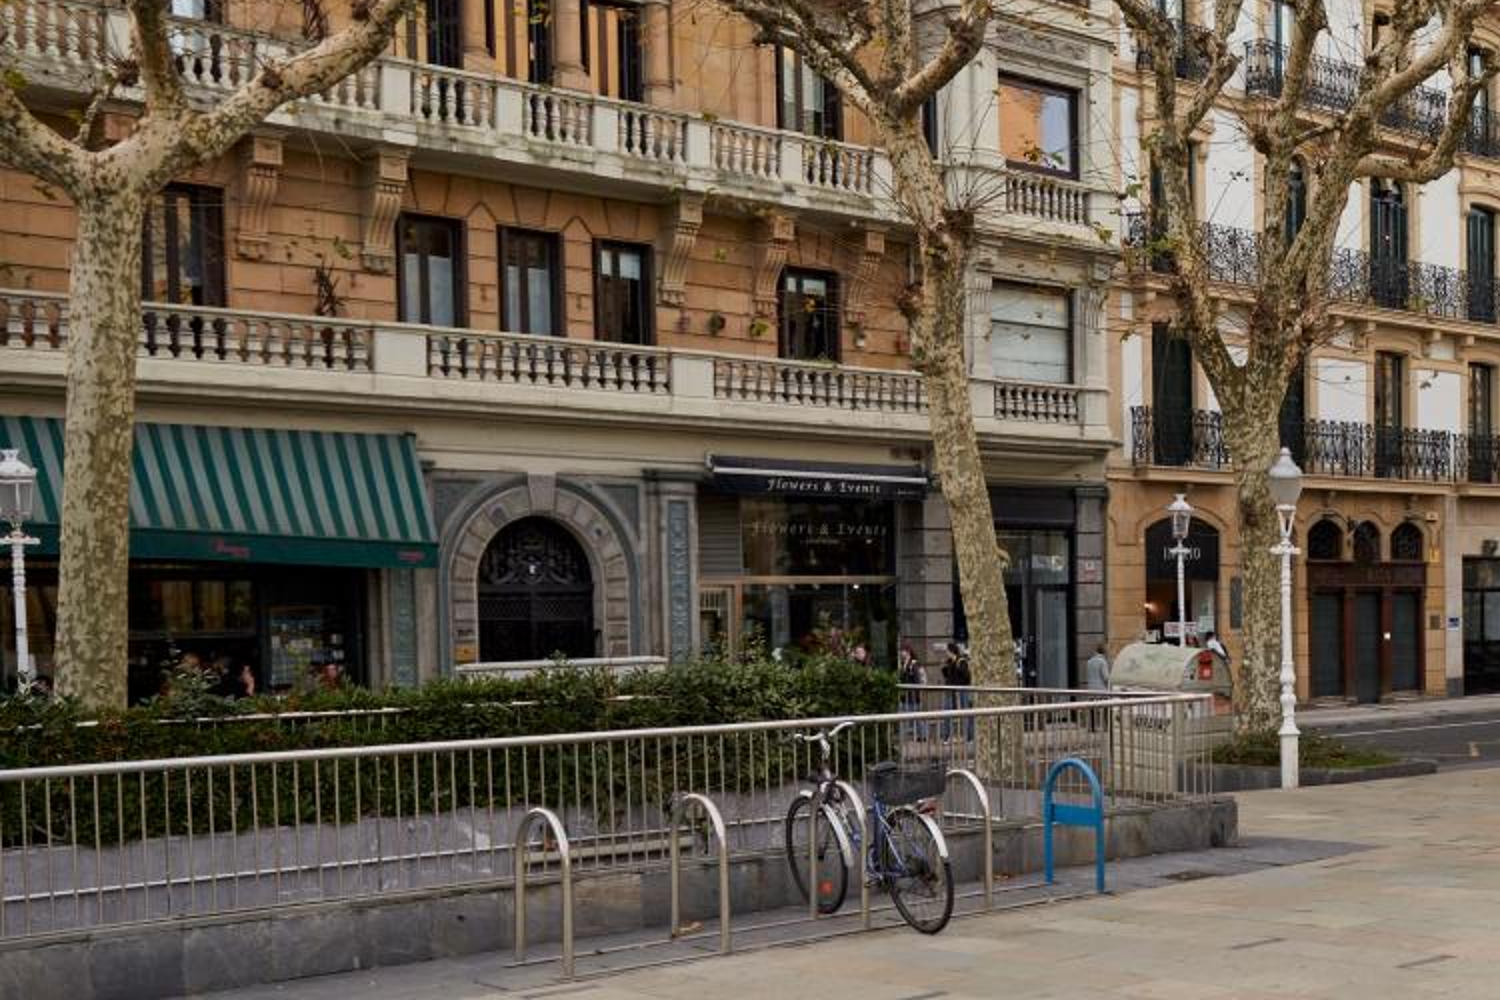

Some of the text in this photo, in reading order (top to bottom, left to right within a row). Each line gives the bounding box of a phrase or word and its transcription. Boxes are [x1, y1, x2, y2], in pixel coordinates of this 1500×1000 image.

[767, 478, 881, 494] Flowers & Events
